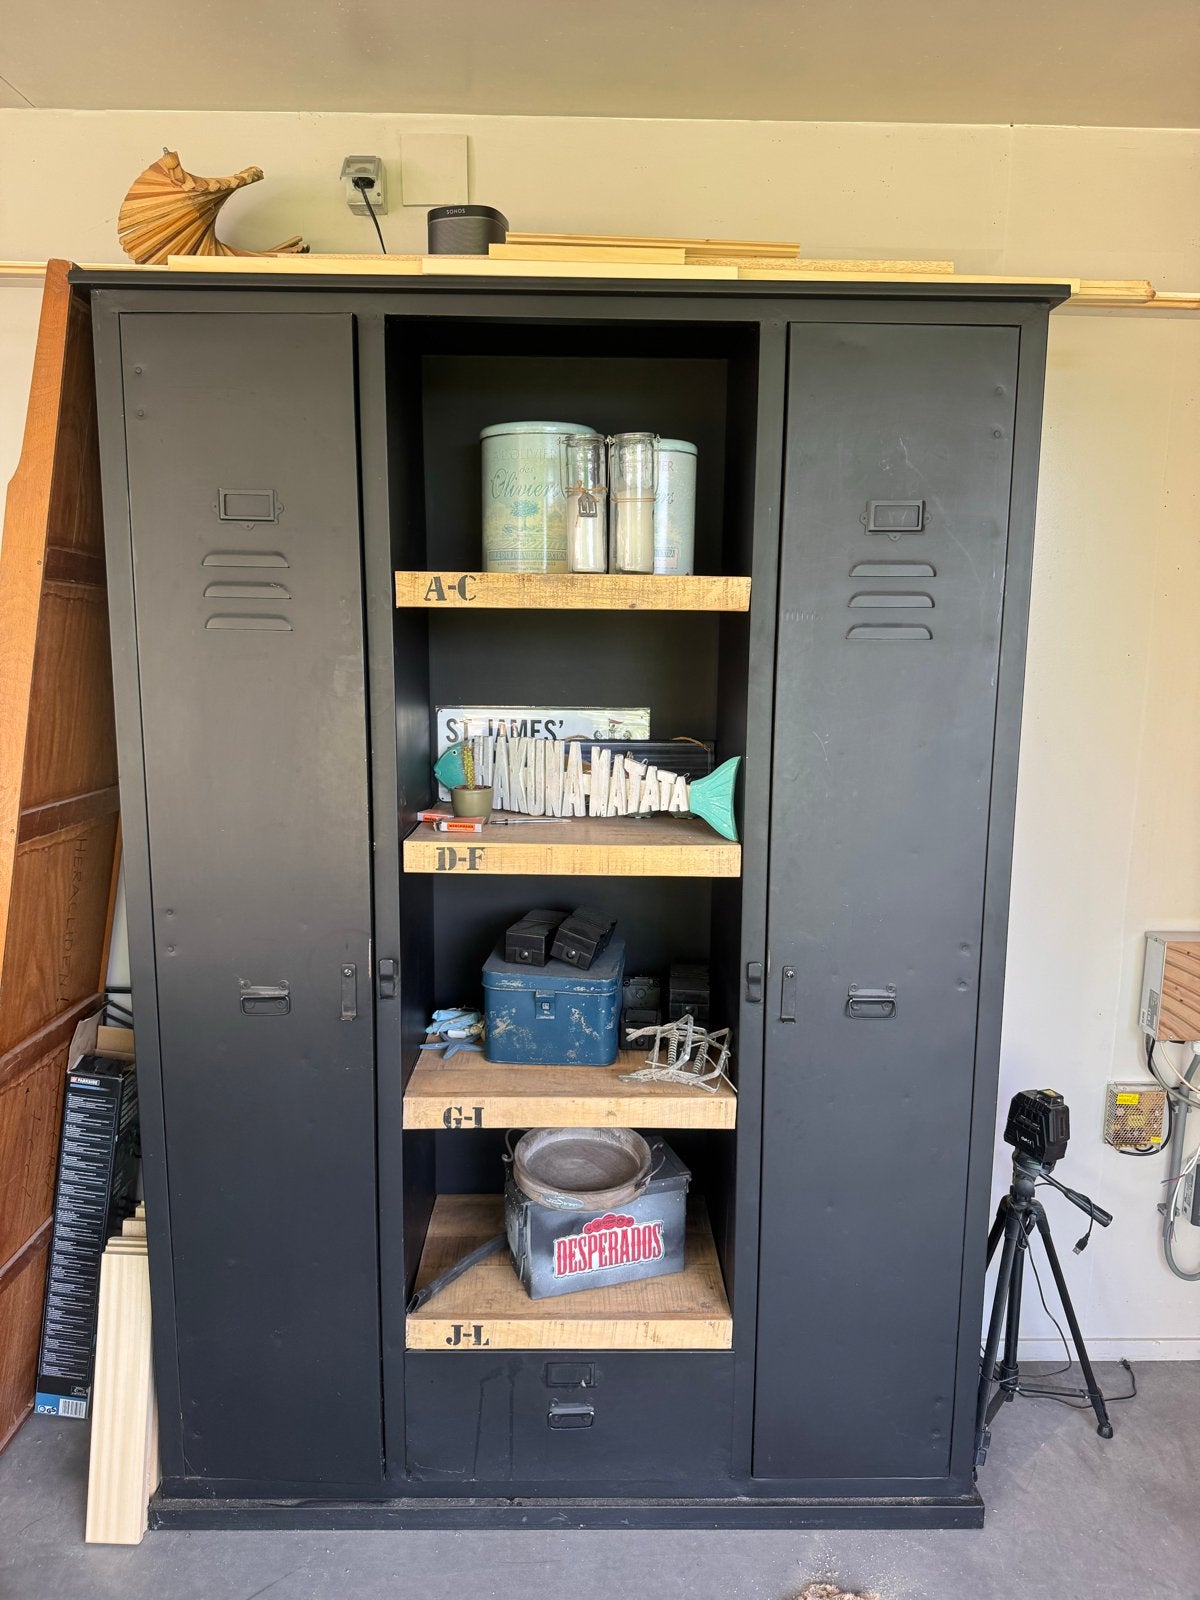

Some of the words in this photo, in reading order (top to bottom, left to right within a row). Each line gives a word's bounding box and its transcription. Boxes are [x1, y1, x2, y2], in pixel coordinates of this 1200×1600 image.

[424, 574, 477, 601] A-C
[473, 735, 587, 817] HAKUNA
[589, 745, 690, 817] MATATA
[435, 846, 486, 871] D-F
[443, 1106, 485, 1129] G-I
[556, 1223, 662, 1276] DESPERADOS
[445, 1324, 490, 1346] J-L
